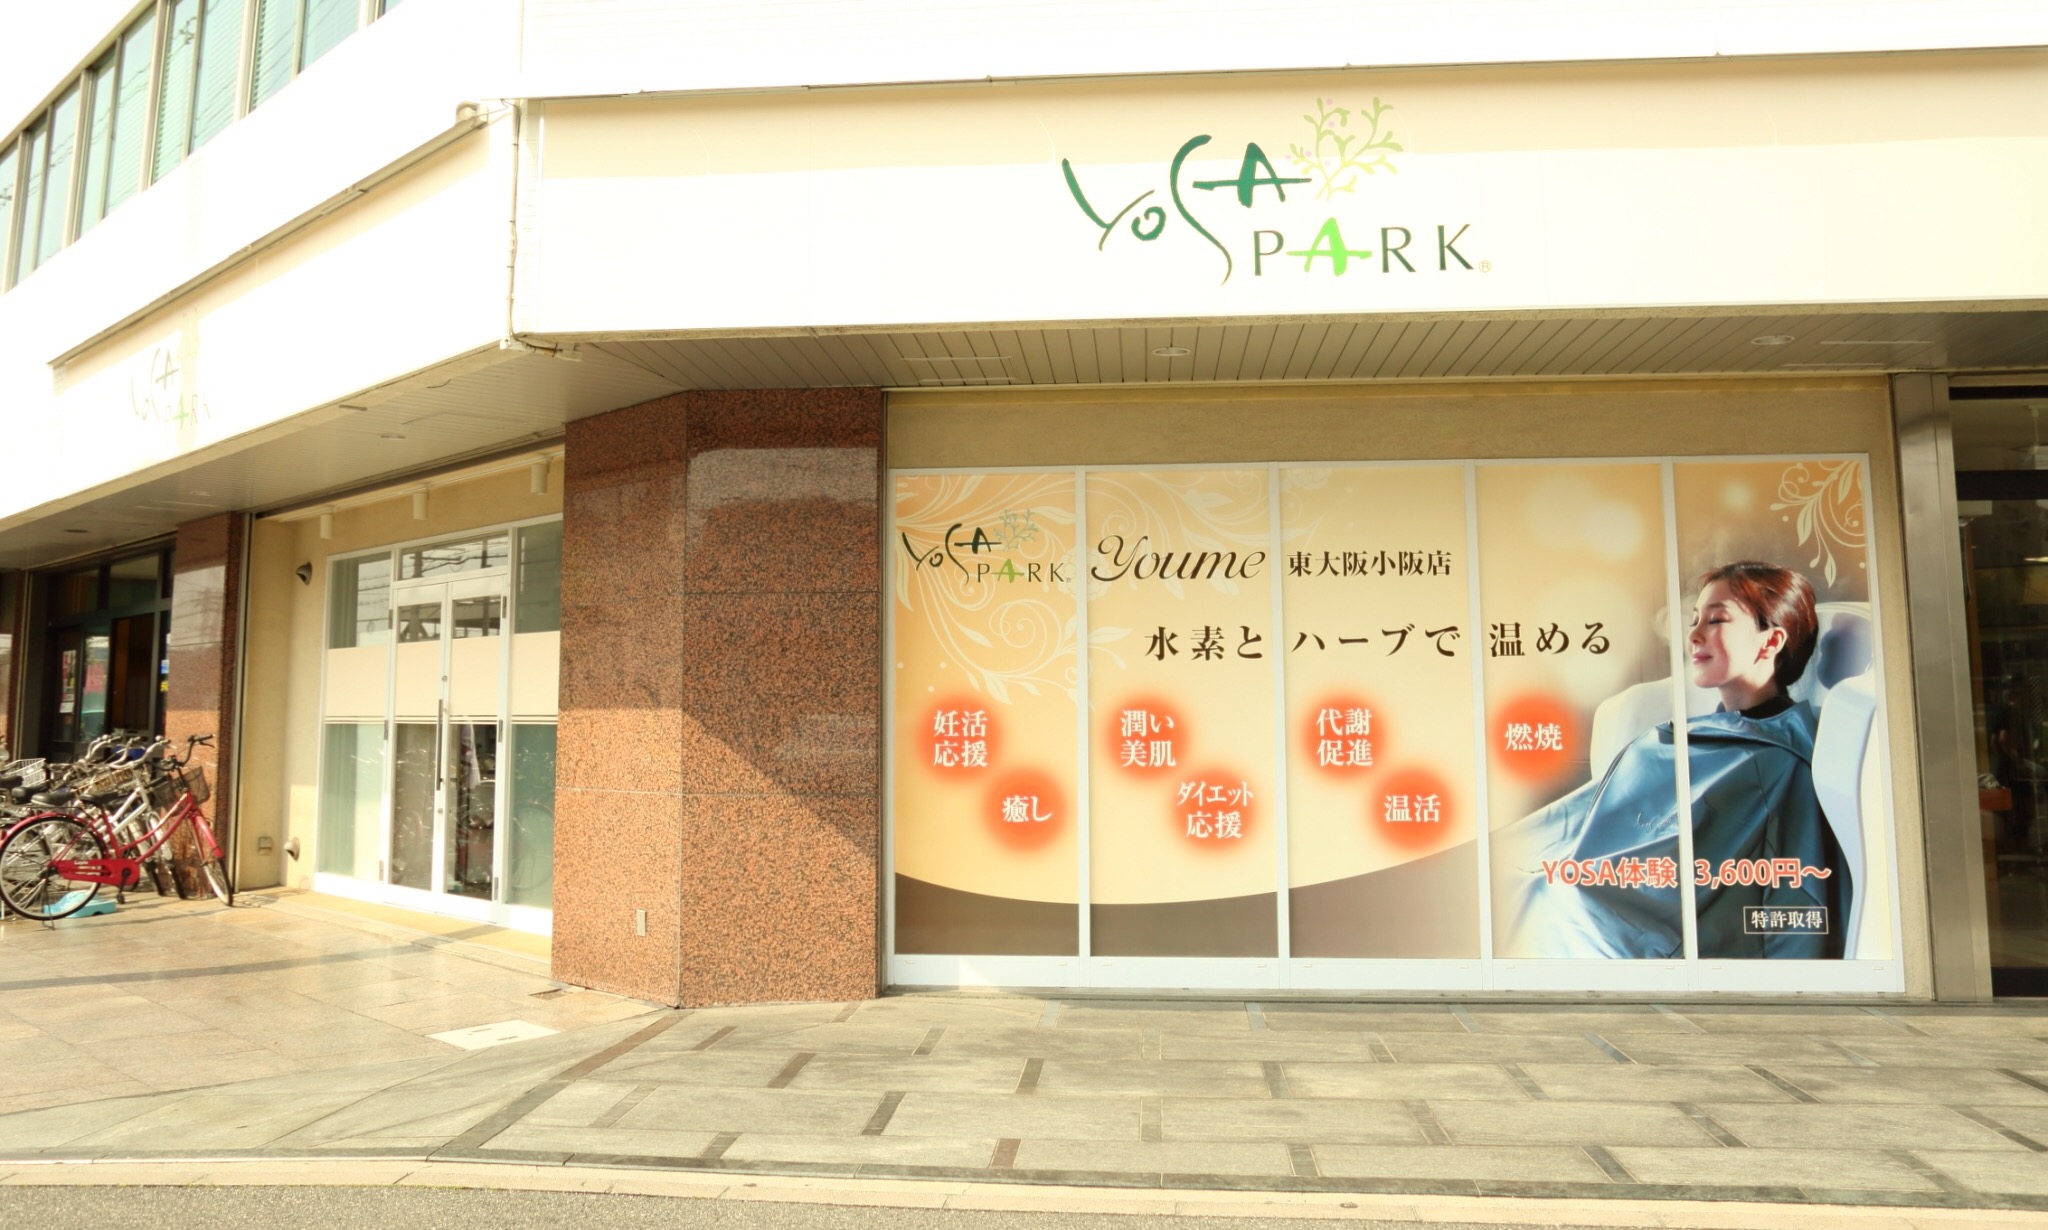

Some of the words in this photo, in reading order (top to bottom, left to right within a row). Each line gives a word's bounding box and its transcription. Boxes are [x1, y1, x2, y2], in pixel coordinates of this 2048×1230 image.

[1062, 134, 1312, 286] YOSA
[1252, 217, 1474, 277] PARK
[902, 523, 1002, 585] YOSA
[1090, 534, 1266, 582] Youme
[1286, 550, 1452, 577] 東大阪小阪店
[977, 559, 1066, 583] PARK
[1144, 625, 1263, 661] 水素と
[1290, 623, 1461, 658] ハーブで
[1488, 621, 1611, 658] 温める
[932, 709, 989, 738] 妊活
[1119, 709, 1176, 737] 潤い
[1315, 708, 1373, 737] 代謝
[1504, 723, 1564, 751] 燃焼
[932, 740, 989, 768] 応援
[1119, 739, 1177, 768] 美肌
[1316, 739, 1373, 767] 促進
[1176, 781, 1254, 807] ダイエット
[1384, 794, 1441, 823] 温活
[1001, 795, 1053, 823] 癒し
[1186, 811, 1243, 839] 応援
[1541, 857, 1678, 888] YOSA体験
[1751, 910, 1824, 930] 特許取得
